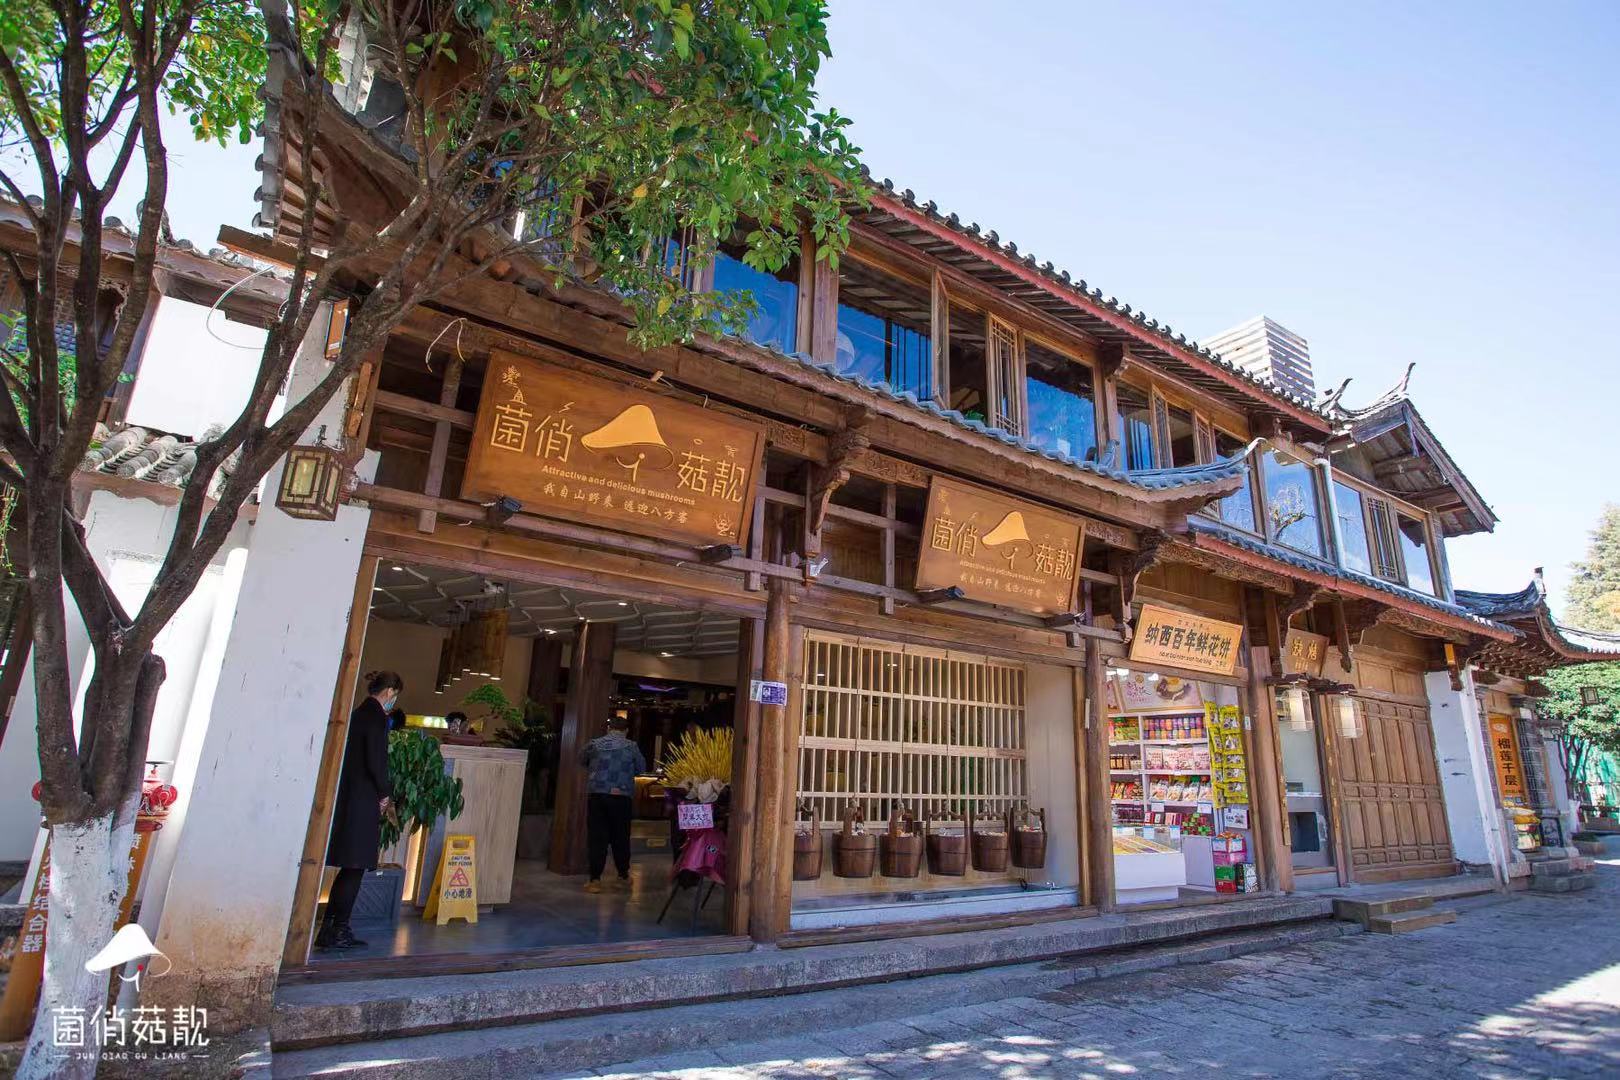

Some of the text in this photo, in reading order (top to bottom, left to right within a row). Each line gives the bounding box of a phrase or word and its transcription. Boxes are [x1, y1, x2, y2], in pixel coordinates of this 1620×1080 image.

[491, 404, 746, 503] 菌俏 菇靓
[541, 465, 696, 506] Attractive and delicious mushrooms
[543, 482, 614, 509] 我自山野来
[930, 517, 978, 558] 菌俏
[1035, 543, 1074, 581] 菇靓
[1144, 622, 1232, 660] 纳西百年鲜花饼
[1498, 738, 1518, 787] 榴莲千层
[444, 888, 472, 899] 小心地滑
